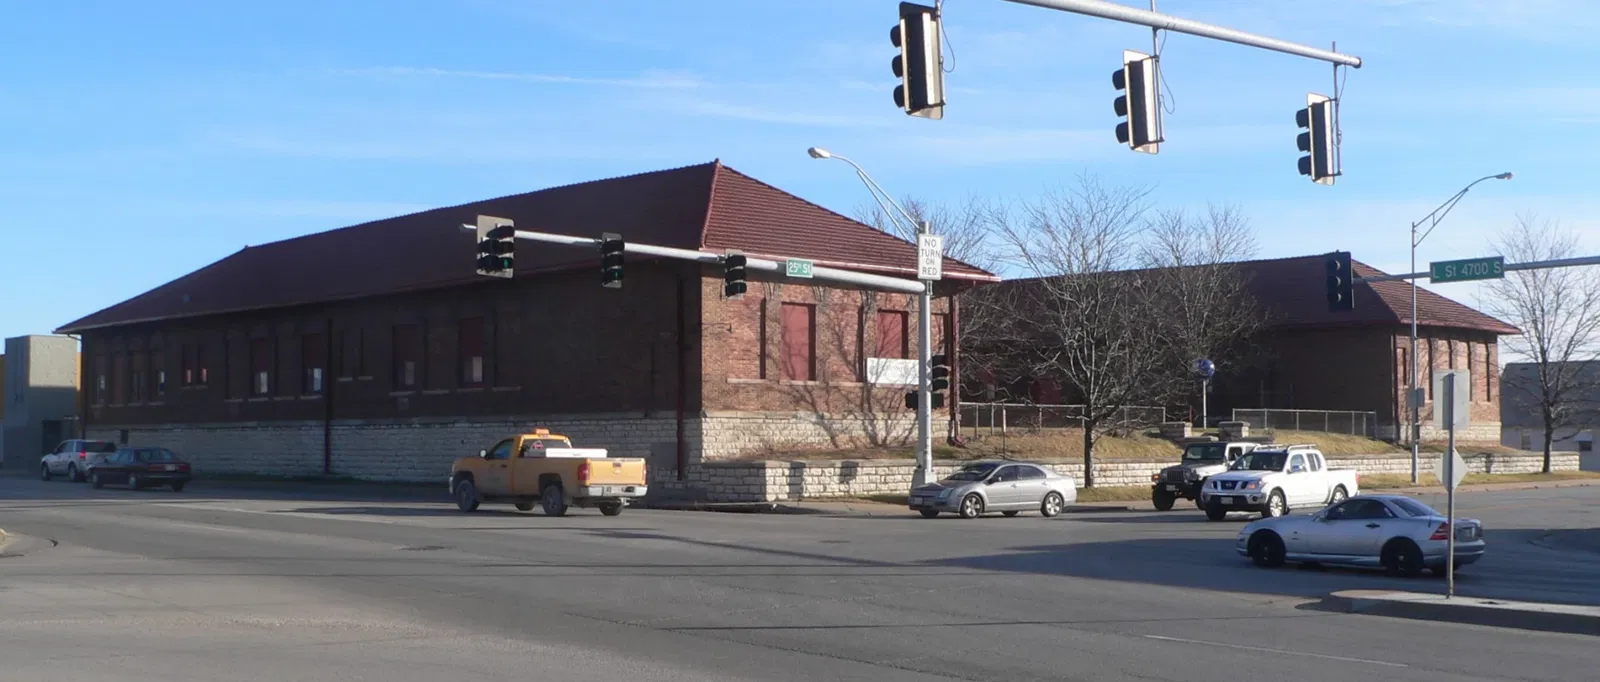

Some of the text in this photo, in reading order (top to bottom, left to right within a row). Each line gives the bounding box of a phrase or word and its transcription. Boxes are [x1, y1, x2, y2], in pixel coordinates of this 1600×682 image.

[924, 238, 937, 248] NO
[921, 248, 941, 259] TURN
[925, 257, 935, 265] ON
[922, 266, 938, 276] RED
[1432, 261, 1502, 279] L St 4700 S
